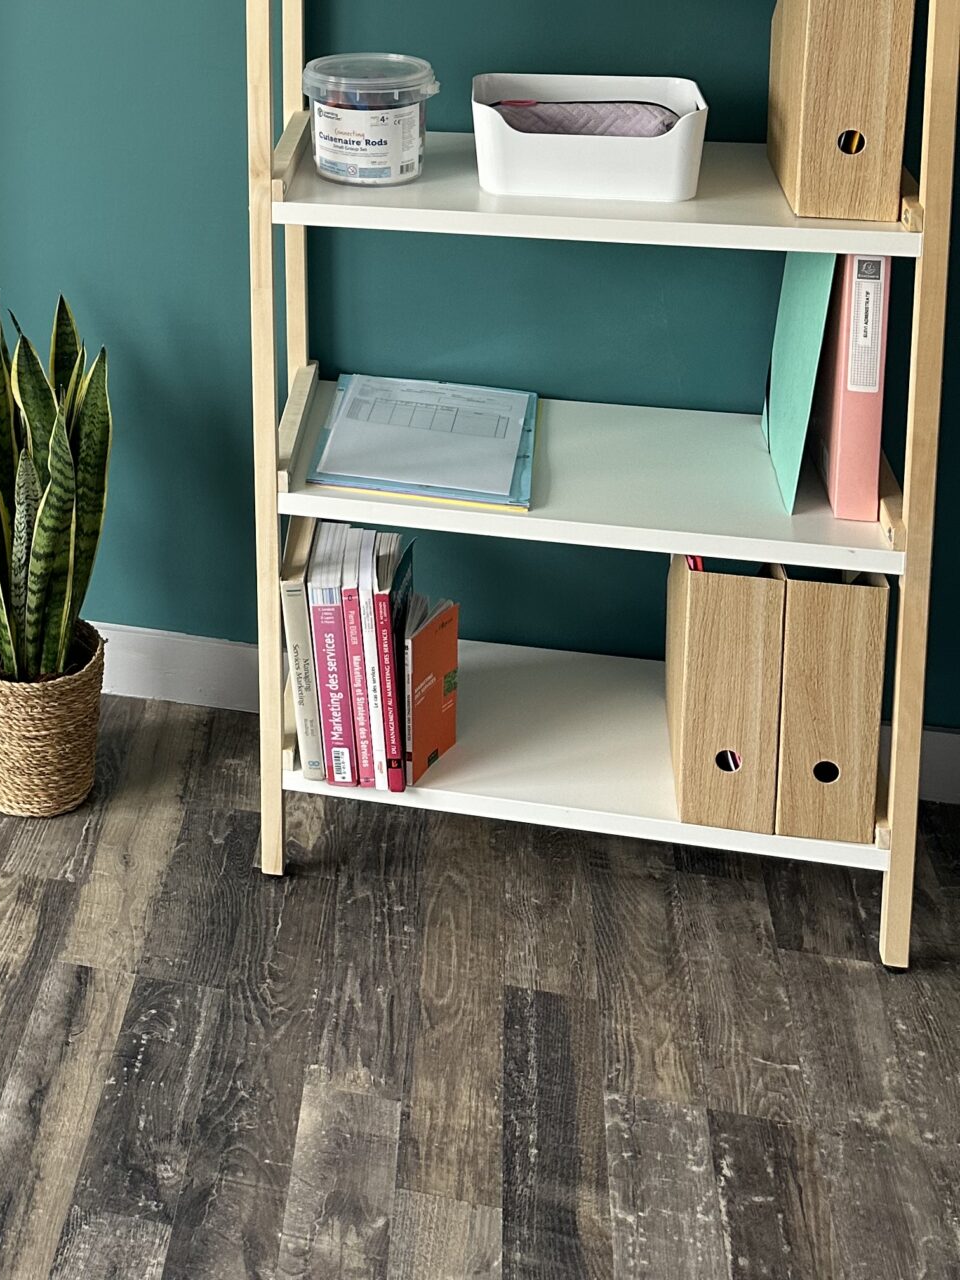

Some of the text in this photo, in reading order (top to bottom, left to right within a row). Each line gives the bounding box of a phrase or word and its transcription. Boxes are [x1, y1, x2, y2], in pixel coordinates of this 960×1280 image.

[334, 128, 365, 139] Connecting
[323, 633, 337, 672] services
[293, 644, 305, 706] Services Marketing
[303, 658, 312, 692] Managing
[325, 674, 339, 690] des
[353, 655, 364, 687] Marketing
[356, 697, 366, 726] Stratégie
[388, 698, 392, 706] AU
[330, 692, 344, 741] Marketing
[360, 727, 368, 739] des
[361, 740, 370, 767] Services
[391, 745, 397, 754] DU
